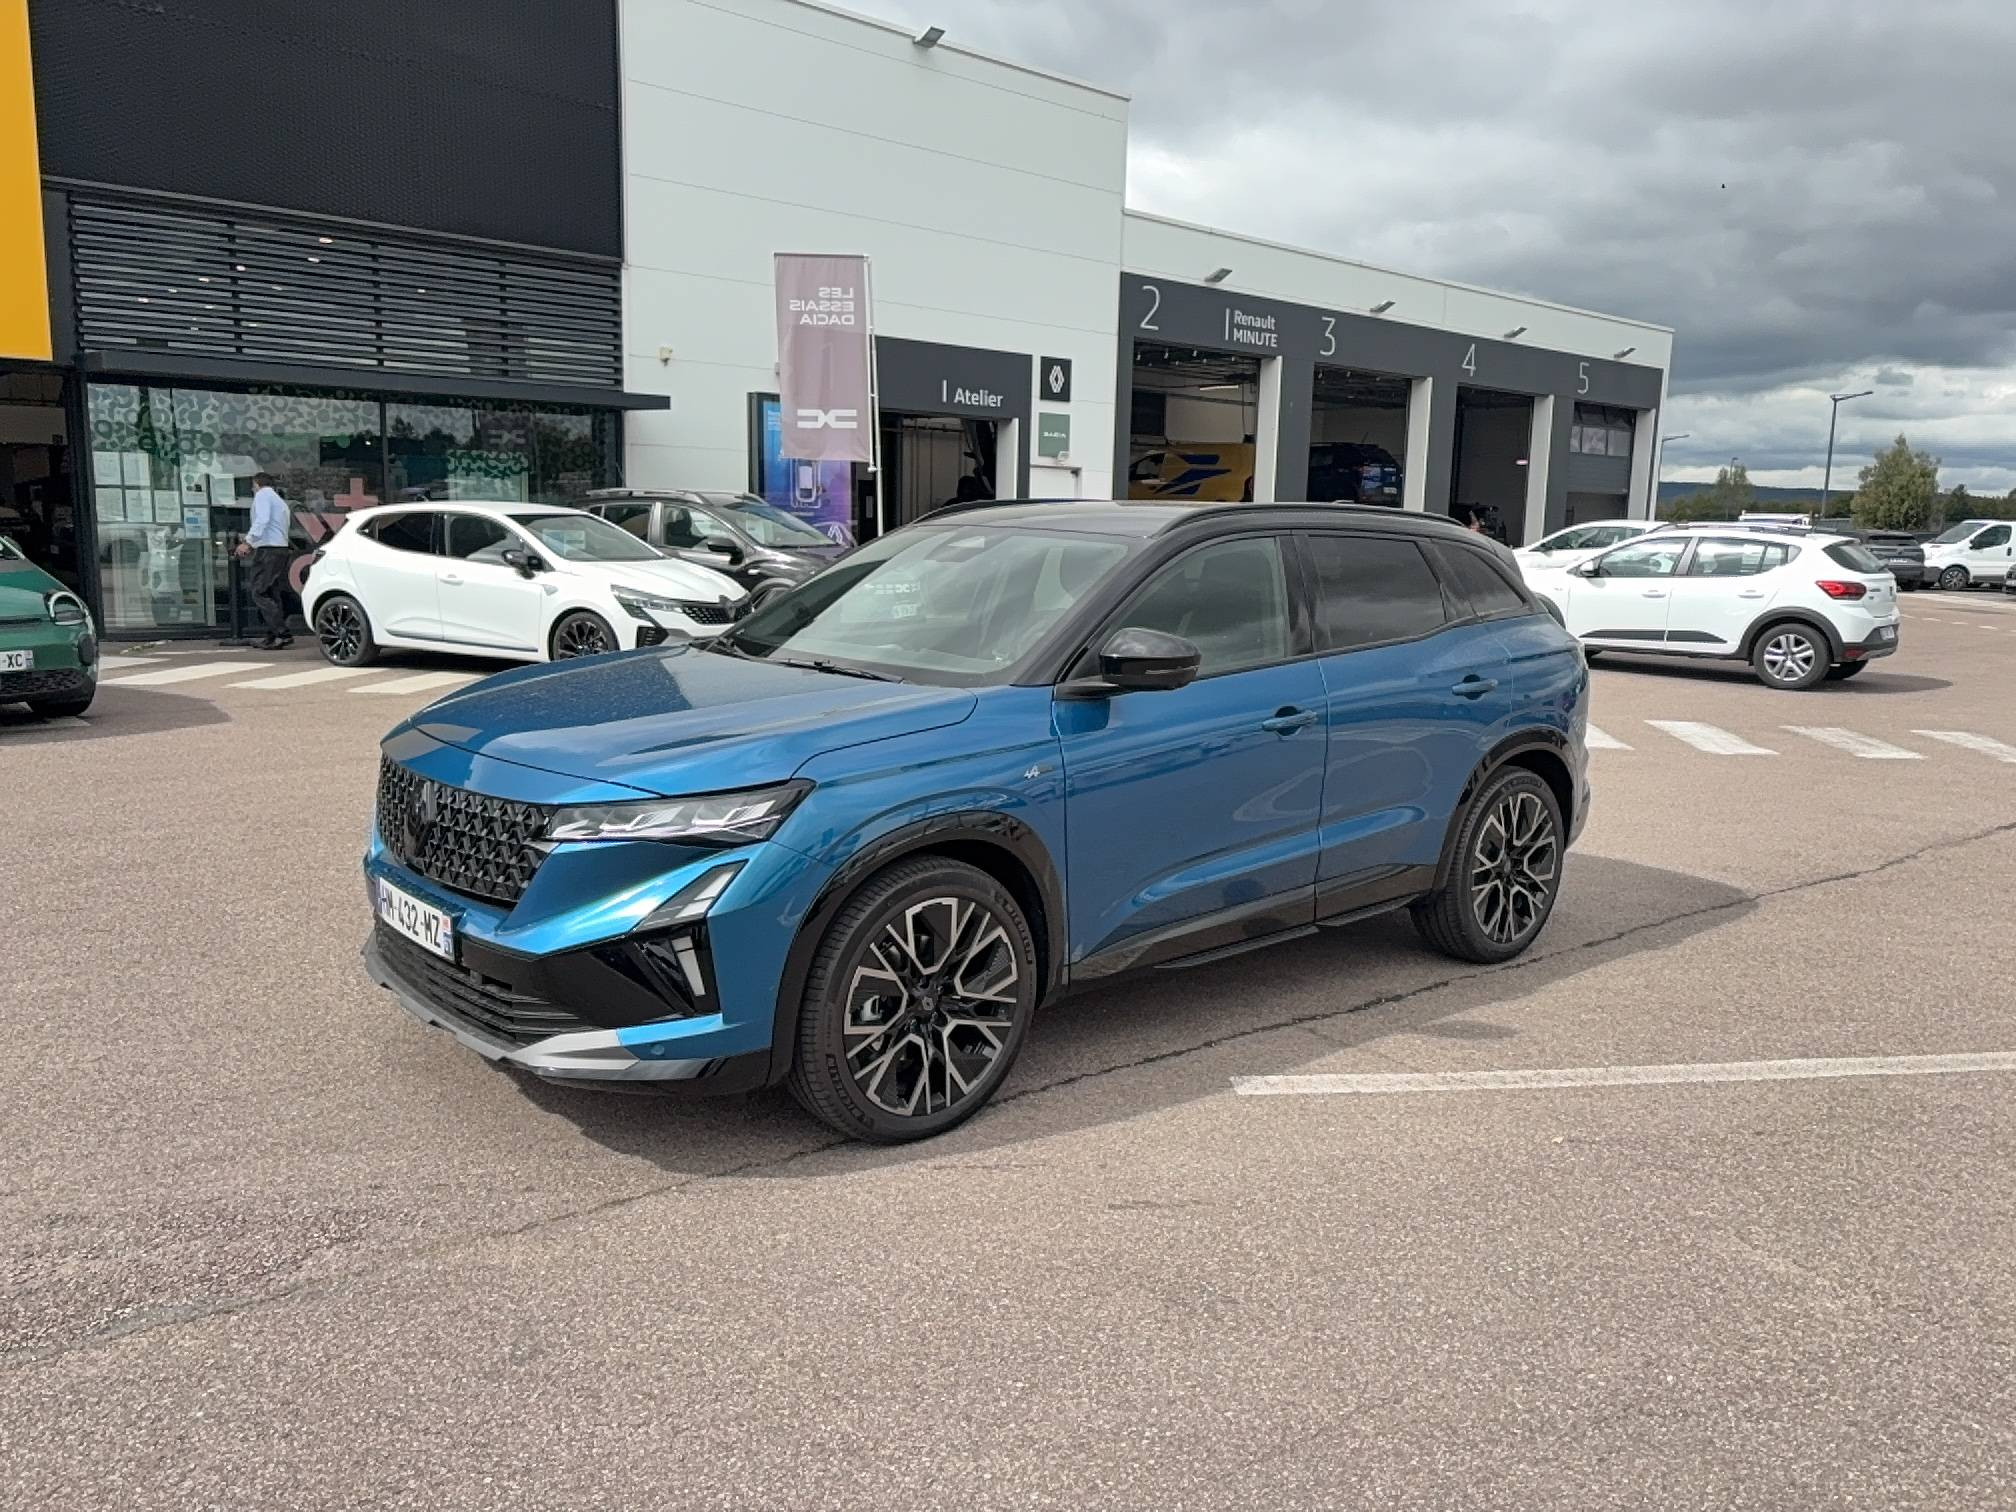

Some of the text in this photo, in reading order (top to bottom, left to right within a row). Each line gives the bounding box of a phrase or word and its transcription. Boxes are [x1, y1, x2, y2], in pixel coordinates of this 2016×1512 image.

[1139, 285, 1161, 331] 2
[1233, 309, 1276, 330] Renault
[1233, 327, 1278, 348] MINUTE
[1319, 316, 1337, 357] 3
[1461, 343, 1476, 377] 4
[1577, 361, 1590, 395] 5
[953, 387, 1004, 408] Atelier
